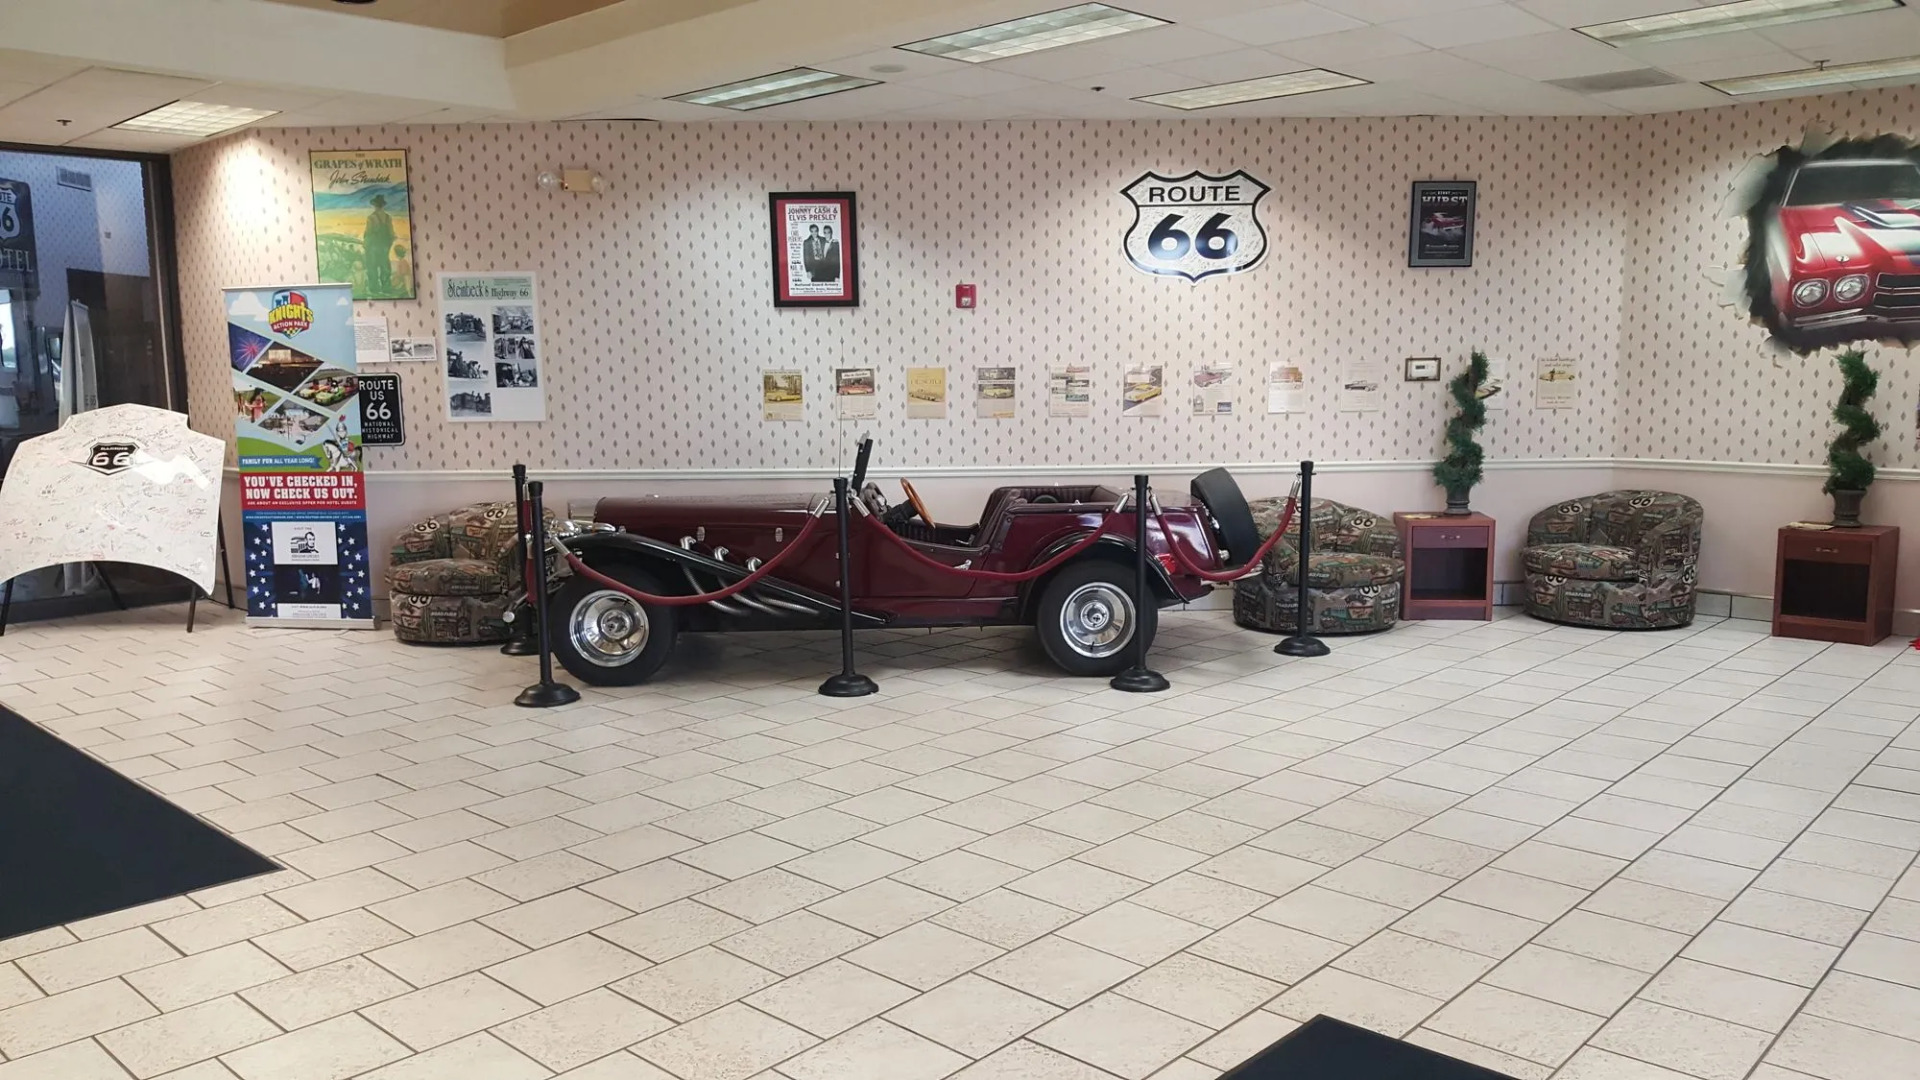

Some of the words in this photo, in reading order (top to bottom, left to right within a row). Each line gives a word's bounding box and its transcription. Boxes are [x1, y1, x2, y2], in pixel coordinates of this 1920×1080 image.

[314, 159, 357, 169] GRAPES
[364, 159, 402, 168] WRATH
[328, 169, 349, 189] John
[351, 170, 392, 185] Steinbeck
[1149, 186, 1240, 203] ROUTE
[1147, 212, 1239, 261] 66
[447, 279, 490, 298] Steinbeck's
[491, 287, 517, 300] Highway
[519, 287, 529, 297] 66
[268, 302, 315, 324] KNIGHTS
[273, 321, 293, 330] ACTION
[293, 320, 308, 328] PARK
[358, 380, 394, 391] ROUTE
[369, 390, 385, 401] US
[366, 402, 391, 420] 66
[91, 451, 134, 467] 66
[243, 475, 284, 488] YOU'VE
[286, 475, 338, 487] CHECKED
[341, 475, 358, 488] IN,
[245, 488, 271, 500] NOW
[274, 488, 311, 499] CHECK
[314, 488, 329, 499] US
[332, 488, 358, 499] OUT.
[1354, 516, 1373, 527] 66
